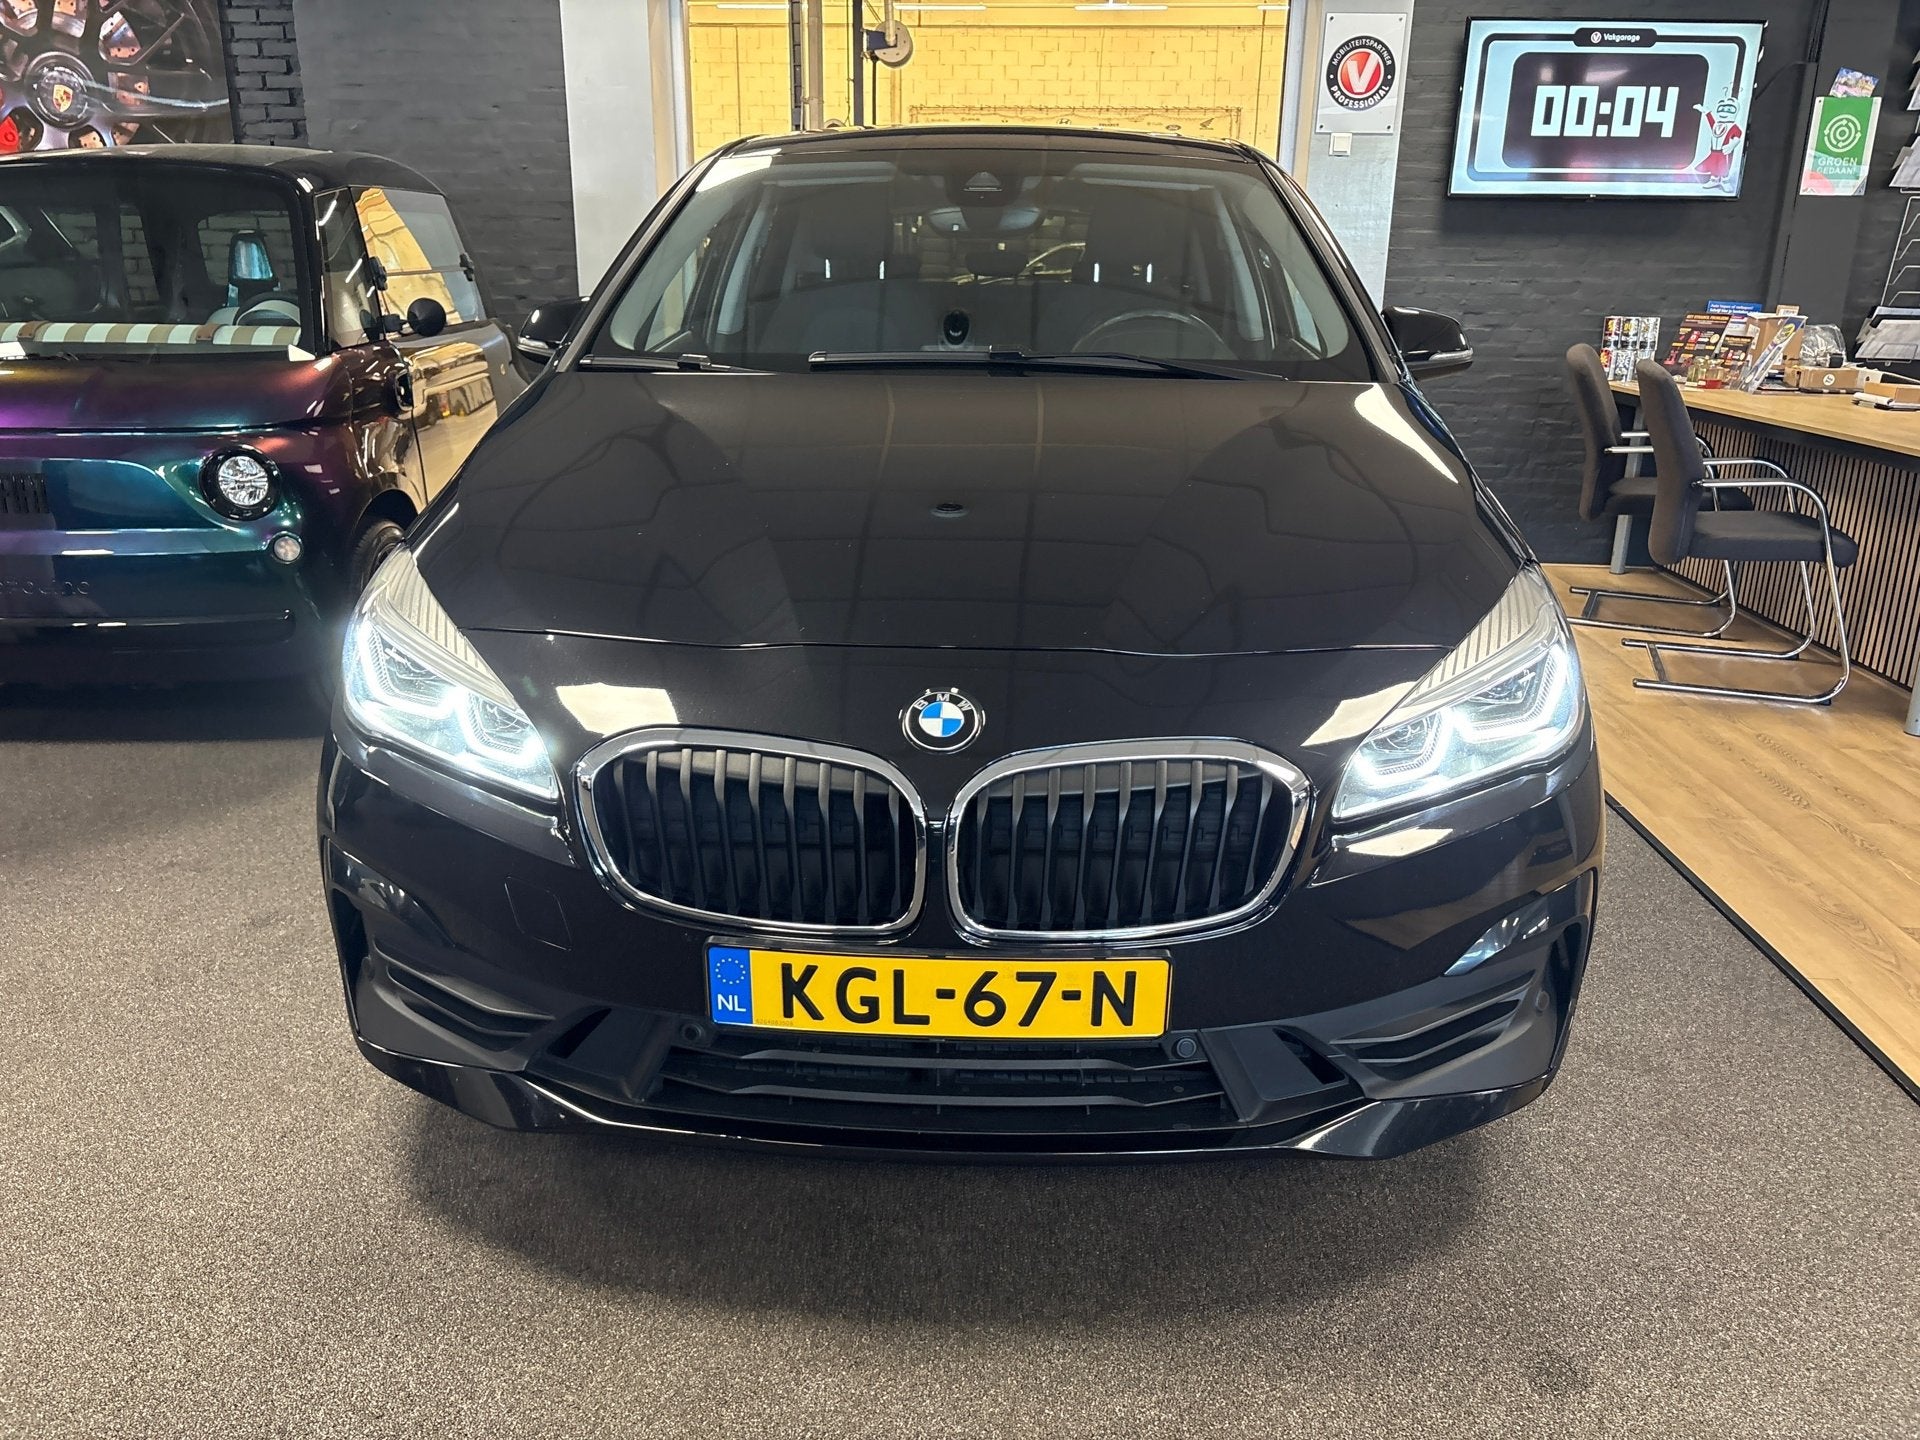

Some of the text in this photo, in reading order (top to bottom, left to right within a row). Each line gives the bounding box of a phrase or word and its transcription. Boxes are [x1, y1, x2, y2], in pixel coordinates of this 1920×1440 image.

[1603, 33, 1640, 42] Vakgarage
[1332, 38, 1392, 66] MOBILITEITSPARTNER
[1330, 86, 1390, 109] PROFESSIONAL
[1531, 85, 1679, 137] 00:04
[1817, 156, 1858, 166] GROEN
[913, 693, 973, 711] BMW
[717, 994, 747, 1013] NL
[781, 962, 1137, 1027] KGL-67-N
